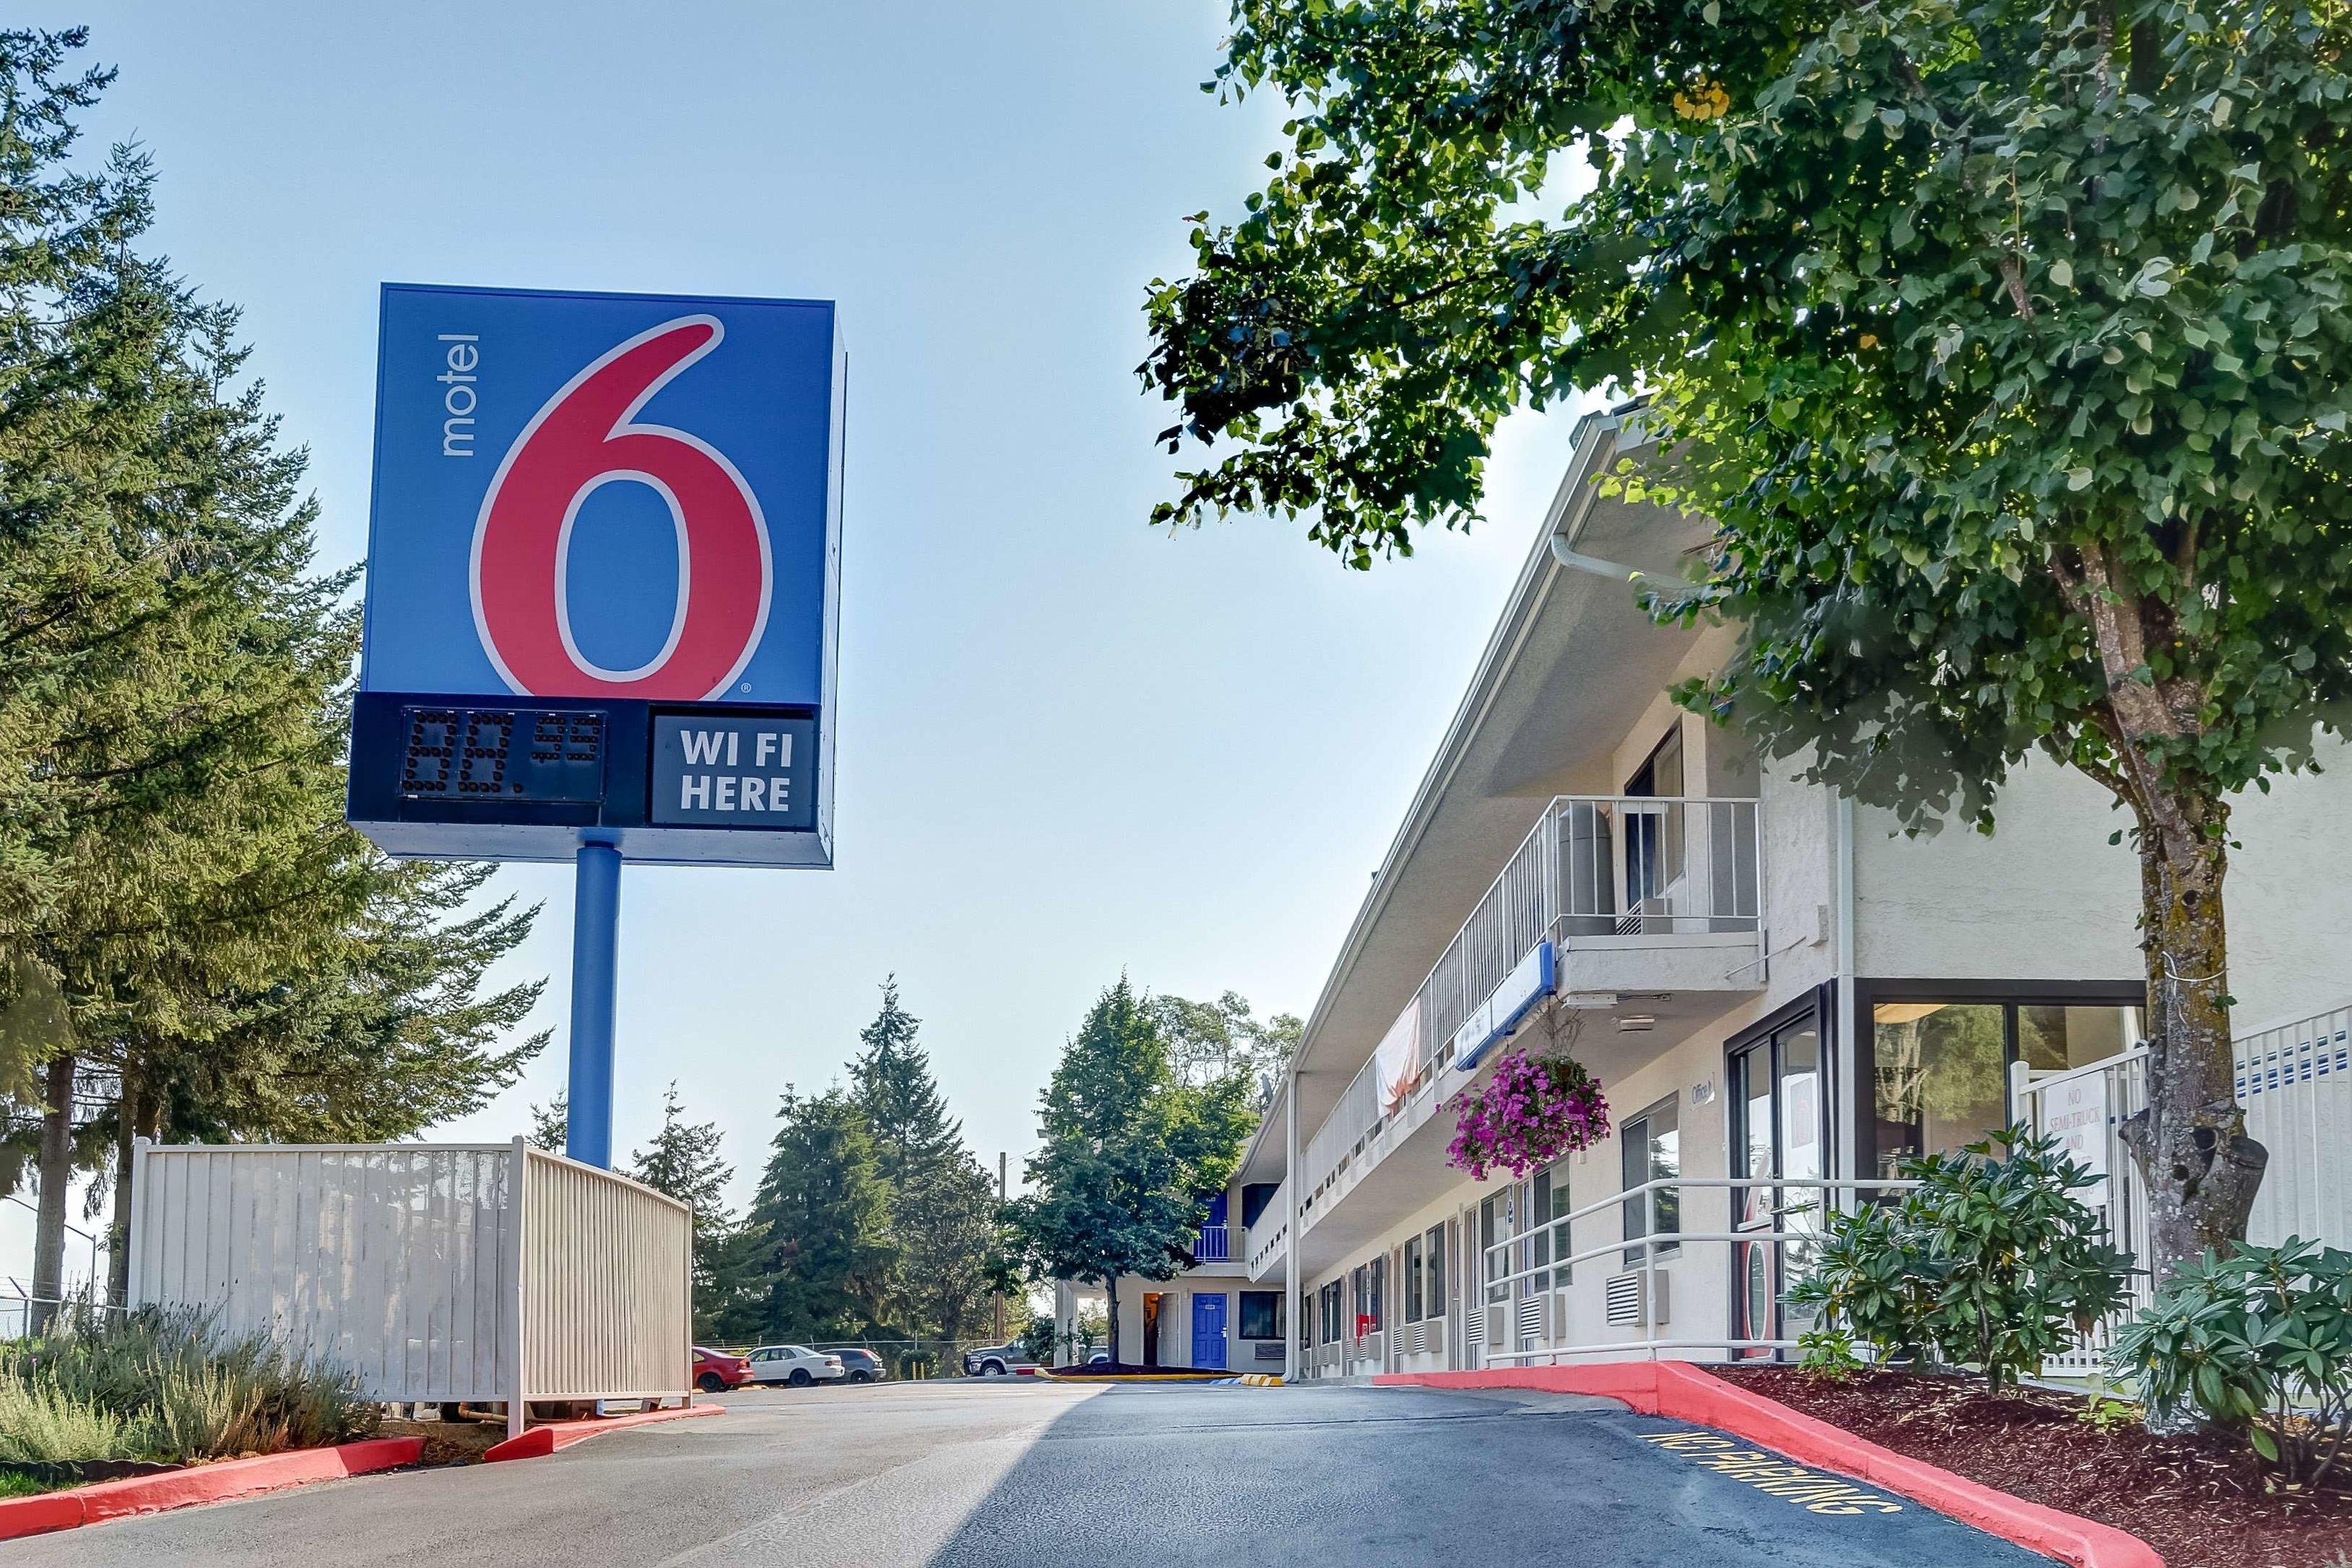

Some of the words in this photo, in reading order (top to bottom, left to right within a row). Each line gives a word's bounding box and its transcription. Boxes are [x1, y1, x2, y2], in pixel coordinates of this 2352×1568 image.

[437, 334, 480, 457] motel
[469, 313, 774, 702] 6
[680, 730, 738, 767] WI
[756, 732, 793, 768] FI
[680, 775, 790, 812] HERE
[2067, 1088, 2082, 1106] NO
[2050, 1106, 2101, 1132] SEMI-TRUCK
[2065, 1134, 2083, 1150] AND
[1636, 1432, 1735, 1450] NO
[1679, 1451, 1903, 1515] PARKING
